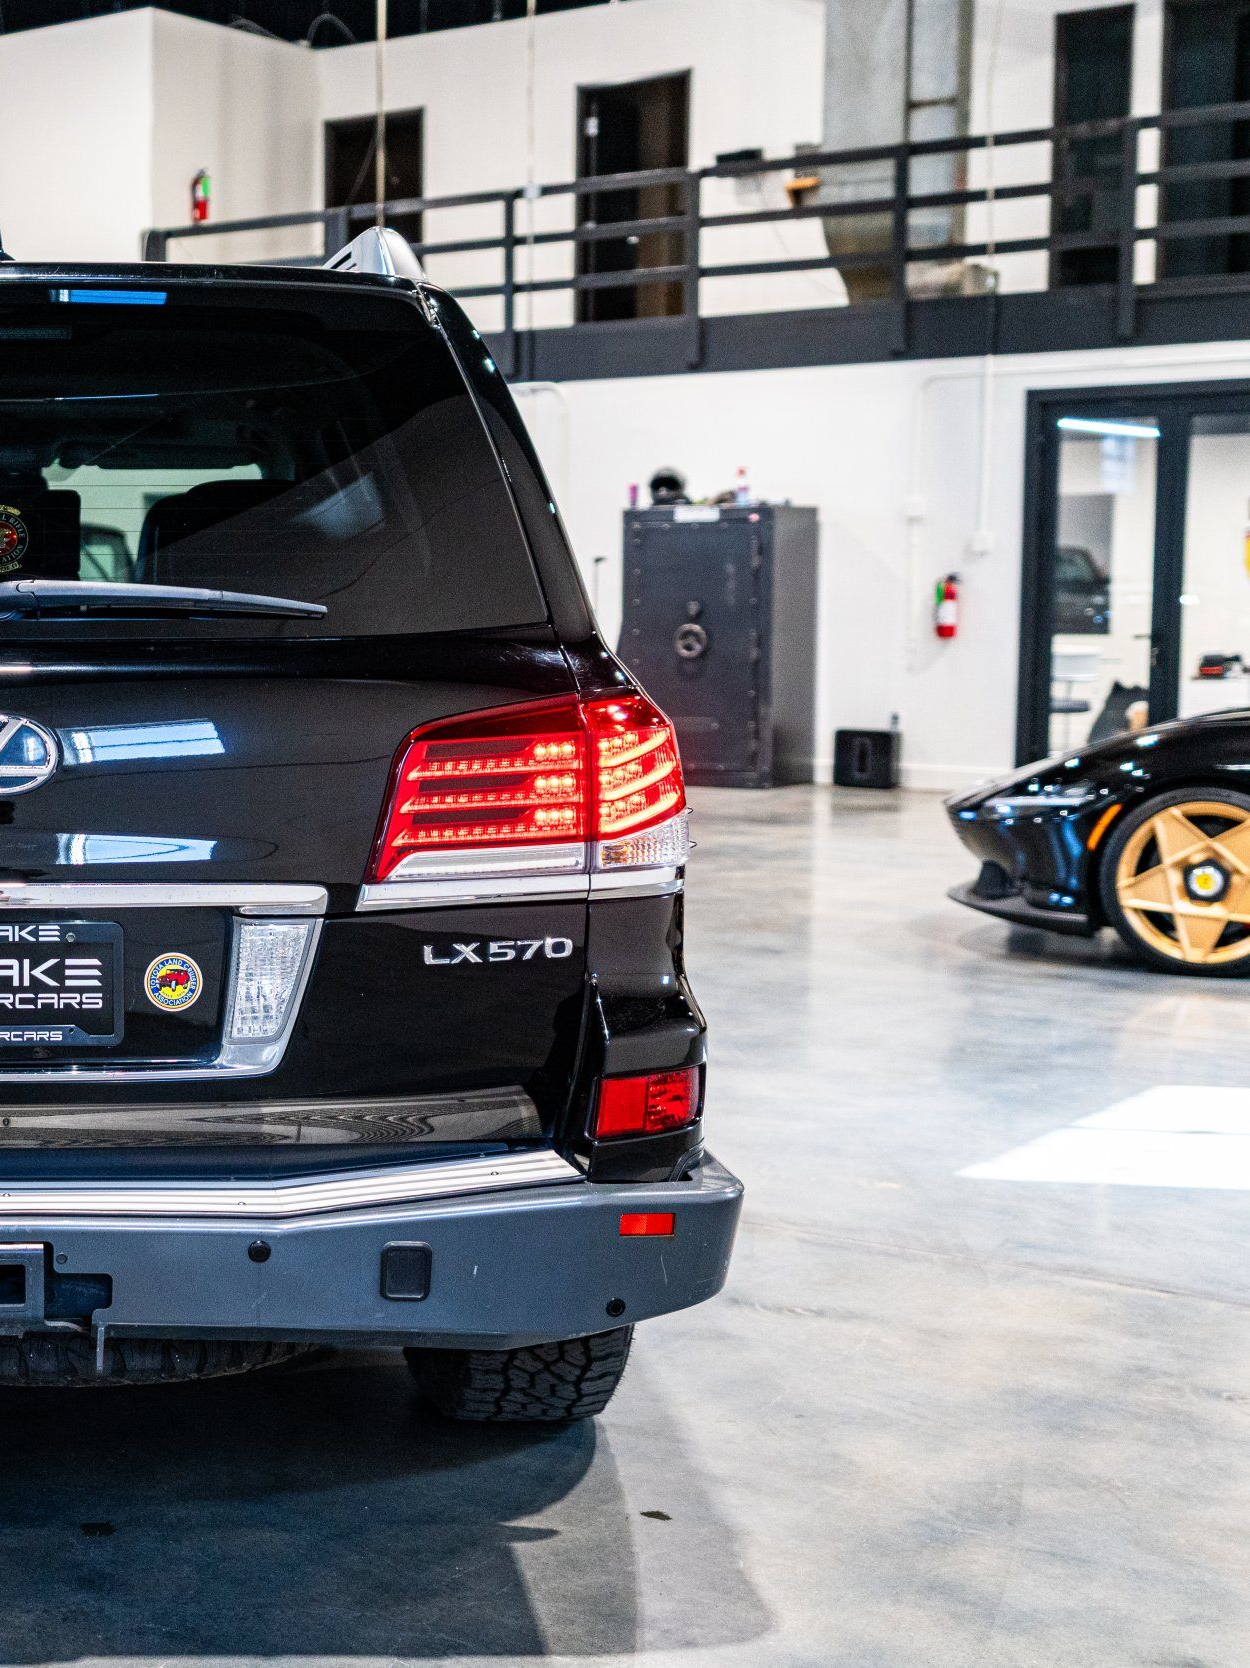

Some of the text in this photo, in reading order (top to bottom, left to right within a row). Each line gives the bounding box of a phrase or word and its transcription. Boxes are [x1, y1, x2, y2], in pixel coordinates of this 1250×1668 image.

[9, 517, 26, 538] RIFLE
[150, 958, 197, 990] TOYOTA LAND CRUISER
[153, 991, 194, 1006] ASSOCIATION
